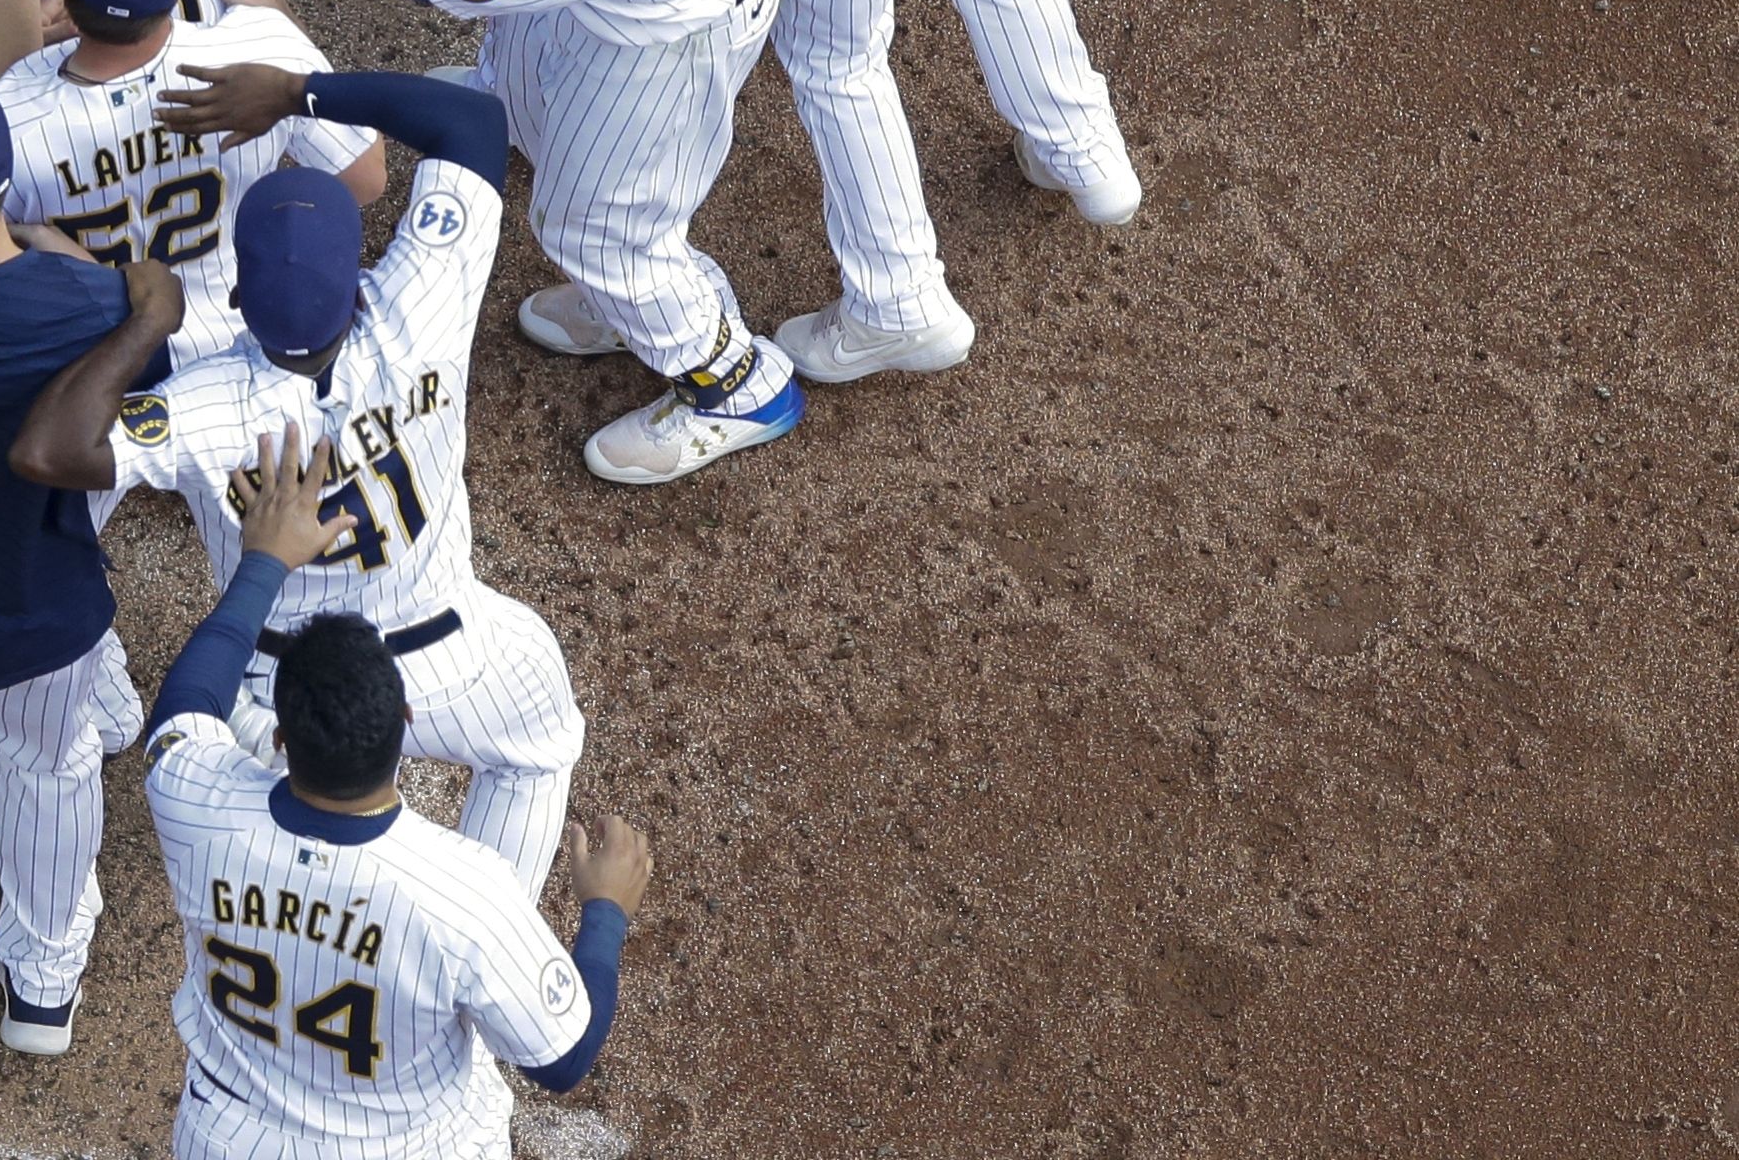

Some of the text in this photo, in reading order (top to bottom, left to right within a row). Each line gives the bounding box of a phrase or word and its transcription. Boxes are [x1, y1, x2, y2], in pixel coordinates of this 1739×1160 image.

[45, 165, 226, 270] 52
[418, 201, 460, 237] 44
[402, 369, 450, 425] JR.
[309, 440, 430, 573] 41
[211, 877, 383, 967] GARCÍA
[204, 934, 384, 1080] 24
[547, 965, 571, 1007] 44
